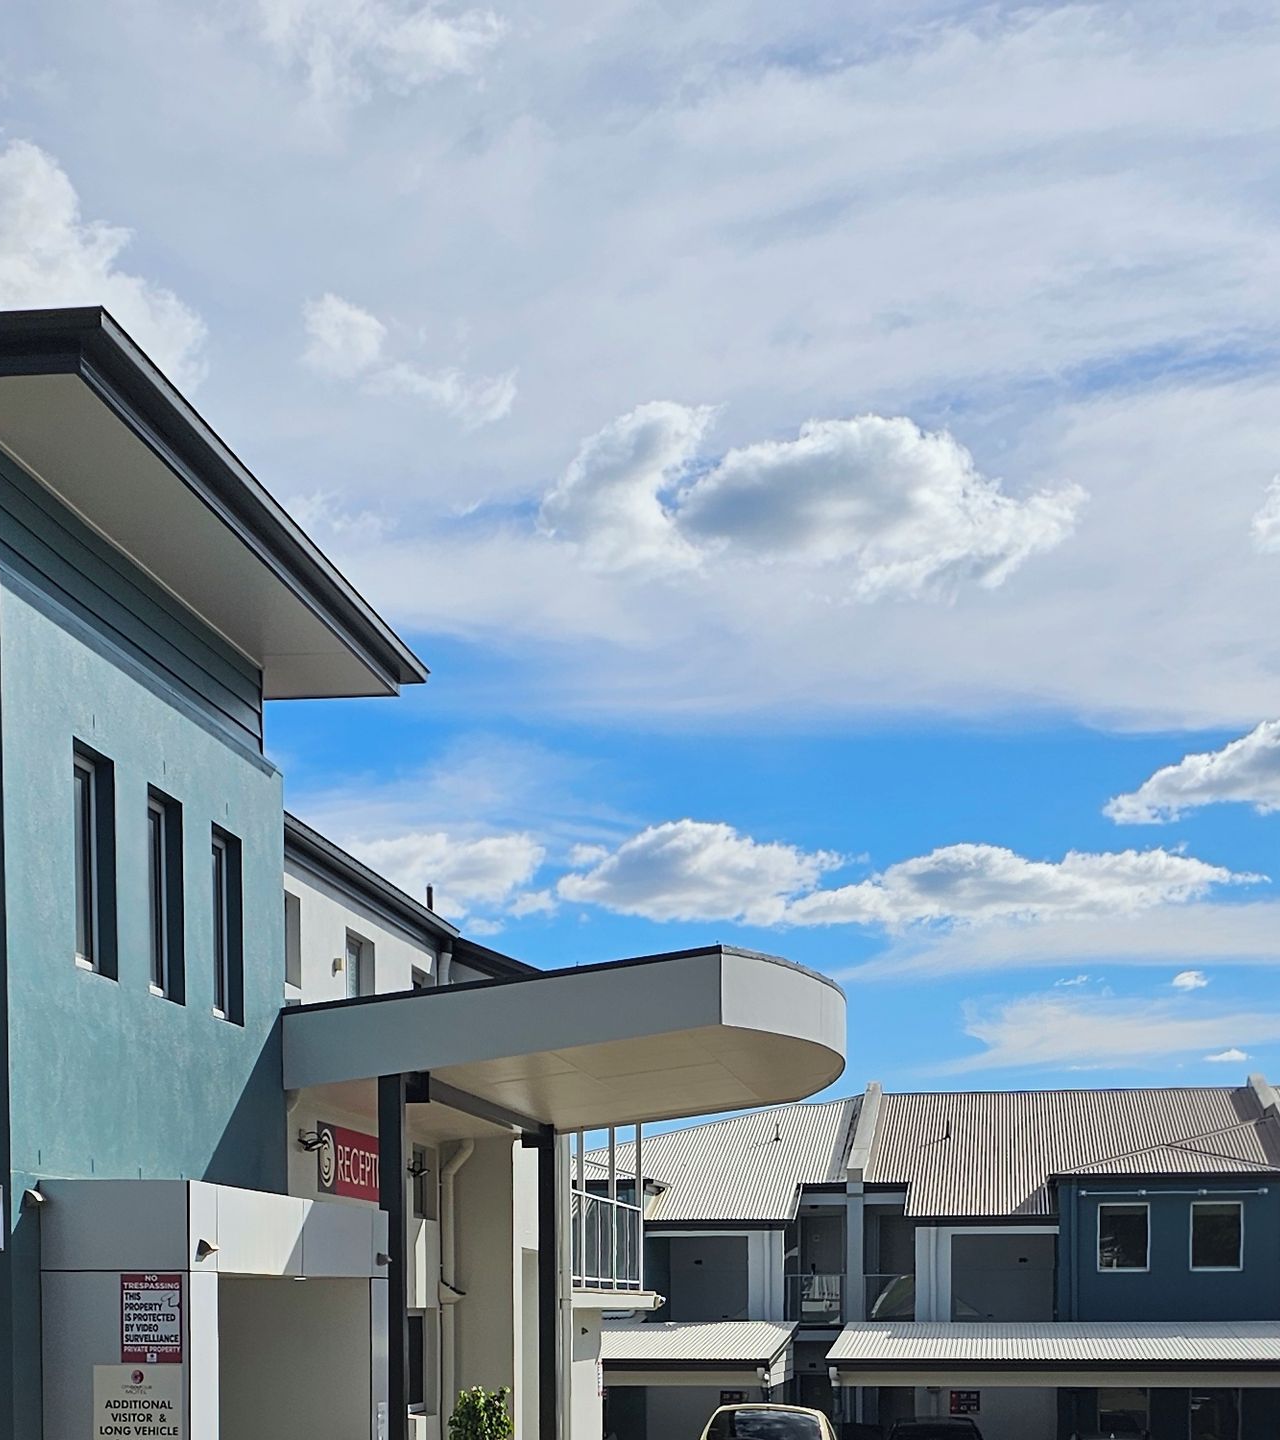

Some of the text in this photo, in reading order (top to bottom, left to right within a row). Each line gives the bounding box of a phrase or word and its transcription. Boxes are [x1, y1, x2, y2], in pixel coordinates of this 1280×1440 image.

[337, 1144, 379, 1189] RECEPTI
[145, 1274, 158, 1282] NO
[123, 1282, 180, 1290] TRESPASSING
[124, 1292, 141, 1301] THIS
[124, 1302, 163, 1311] PROPERTY
[124, 1313, 176, 1322] IS PROTECTED
[124, 1323, 159, 1332] BY VIDEO
[105, 1400, 174, 1409] ADDITIONAL
[111, 1412, 167, 1422] VISITOR &
[100, 1426, 179, 1436] LONG VEHICLE
